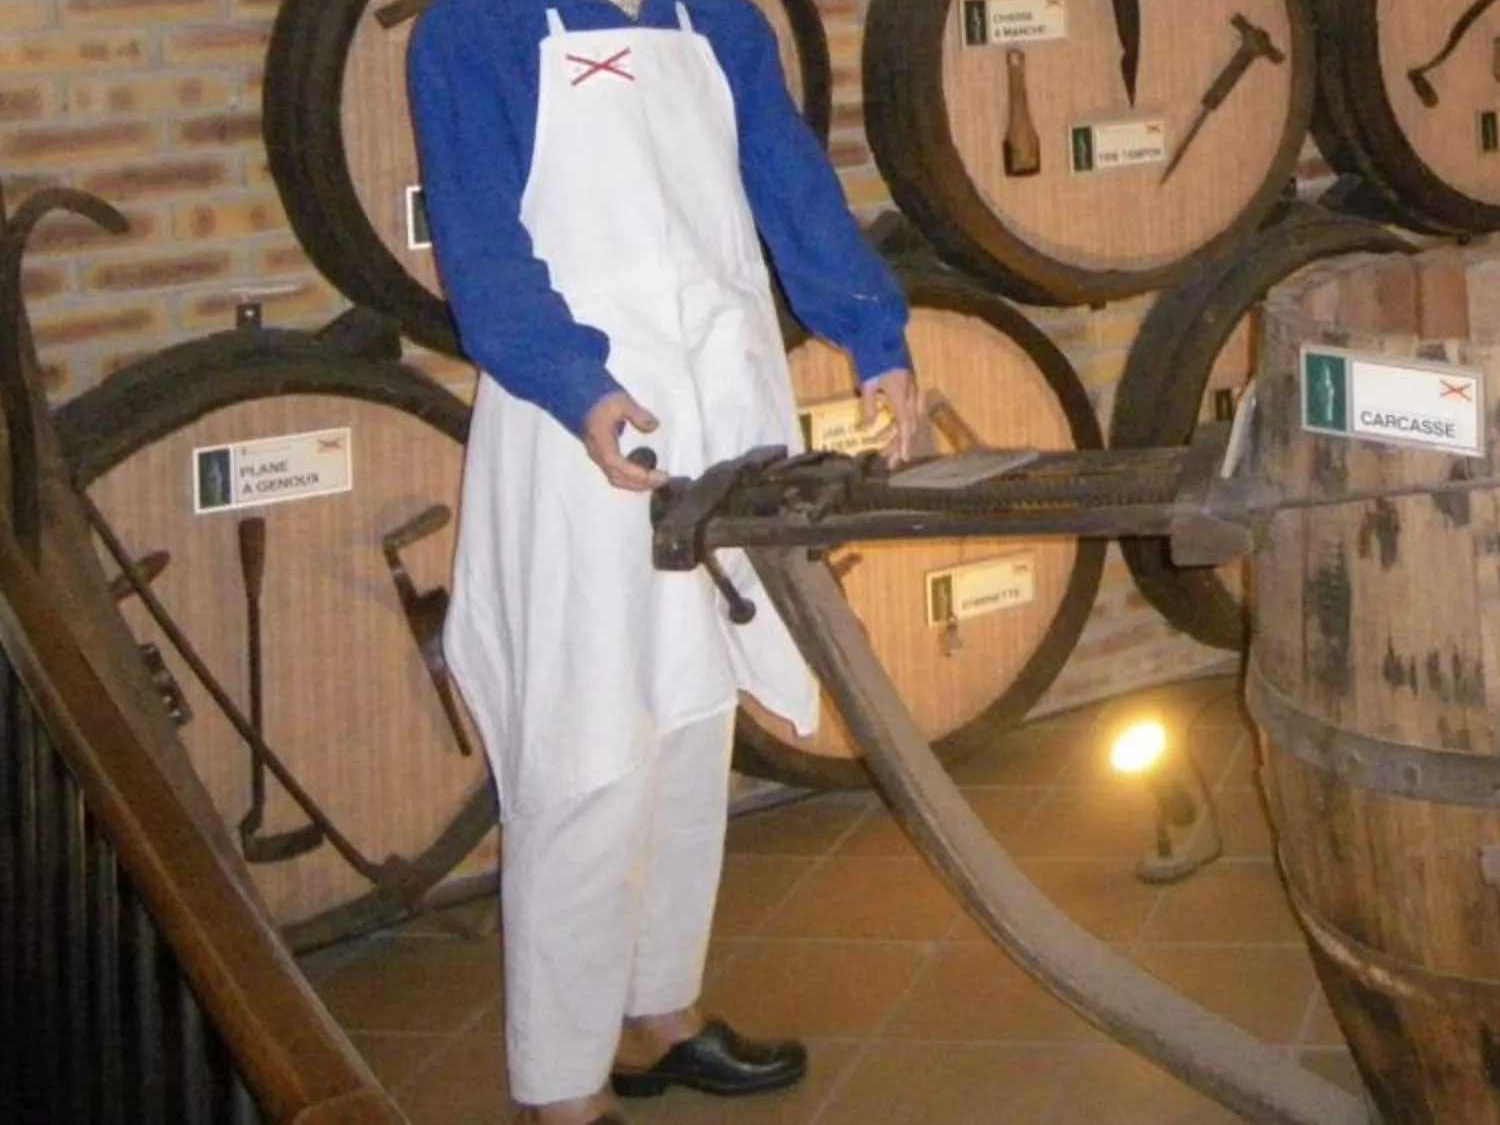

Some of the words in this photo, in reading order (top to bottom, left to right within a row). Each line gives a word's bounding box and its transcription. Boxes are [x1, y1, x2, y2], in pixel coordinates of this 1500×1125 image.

[1360, 410, 1457, 439] CARCASSE
[239, 460, 288, 479] PLANE
[255, 472, 320, 494] GENOUX
